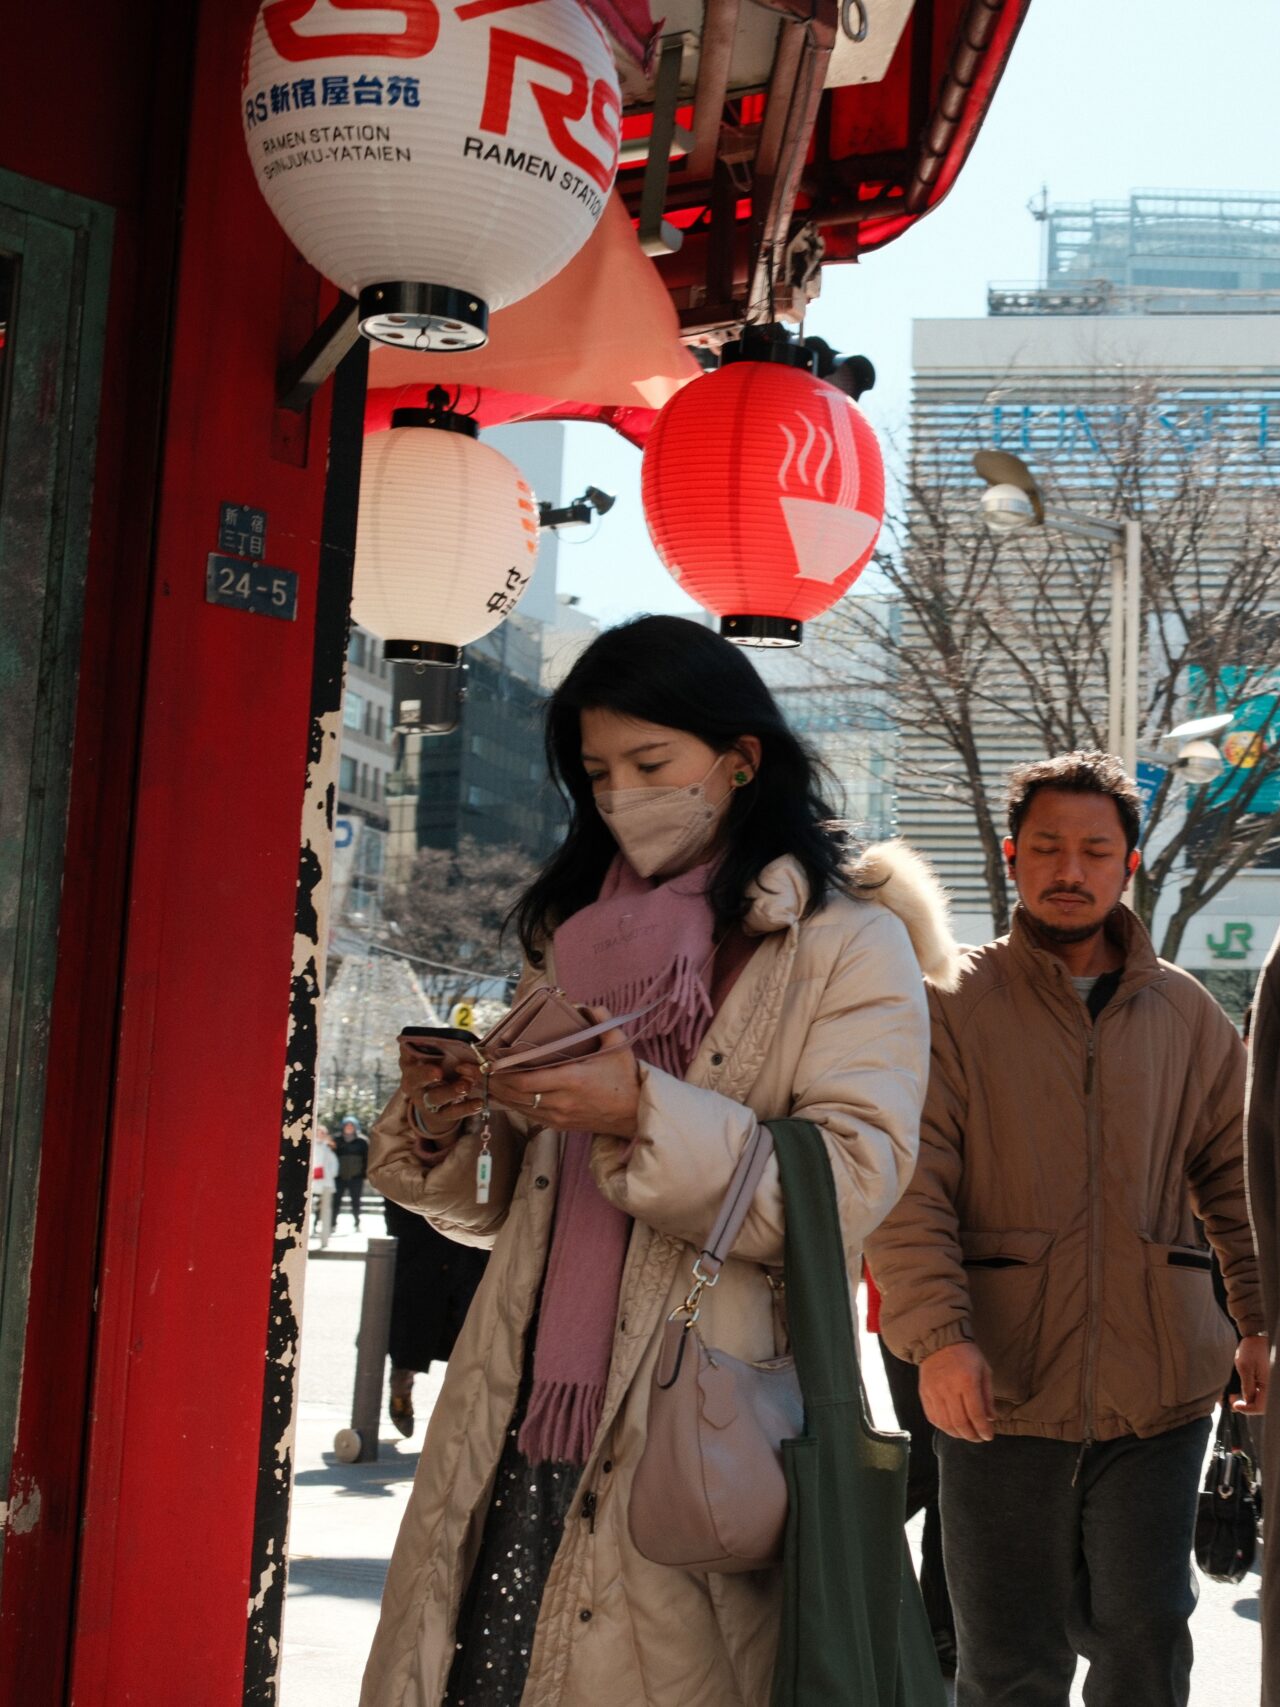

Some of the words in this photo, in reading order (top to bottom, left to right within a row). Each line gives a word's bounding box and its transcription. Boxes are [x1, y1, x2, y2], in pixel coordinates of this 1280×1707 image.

[263, 130, 306, 156] RAMEN
[310, 125, 390, 144] STATION
[463, 136, 558, 183] RAMEN
[559, 170, 602, 222] STATIO
[223, 528, 262, 555] 三丁目
[218, 567, 289, 607] 24-5
[1206, 922, 1254, 955] JR
[458, 1006, 470, 1027] 2
